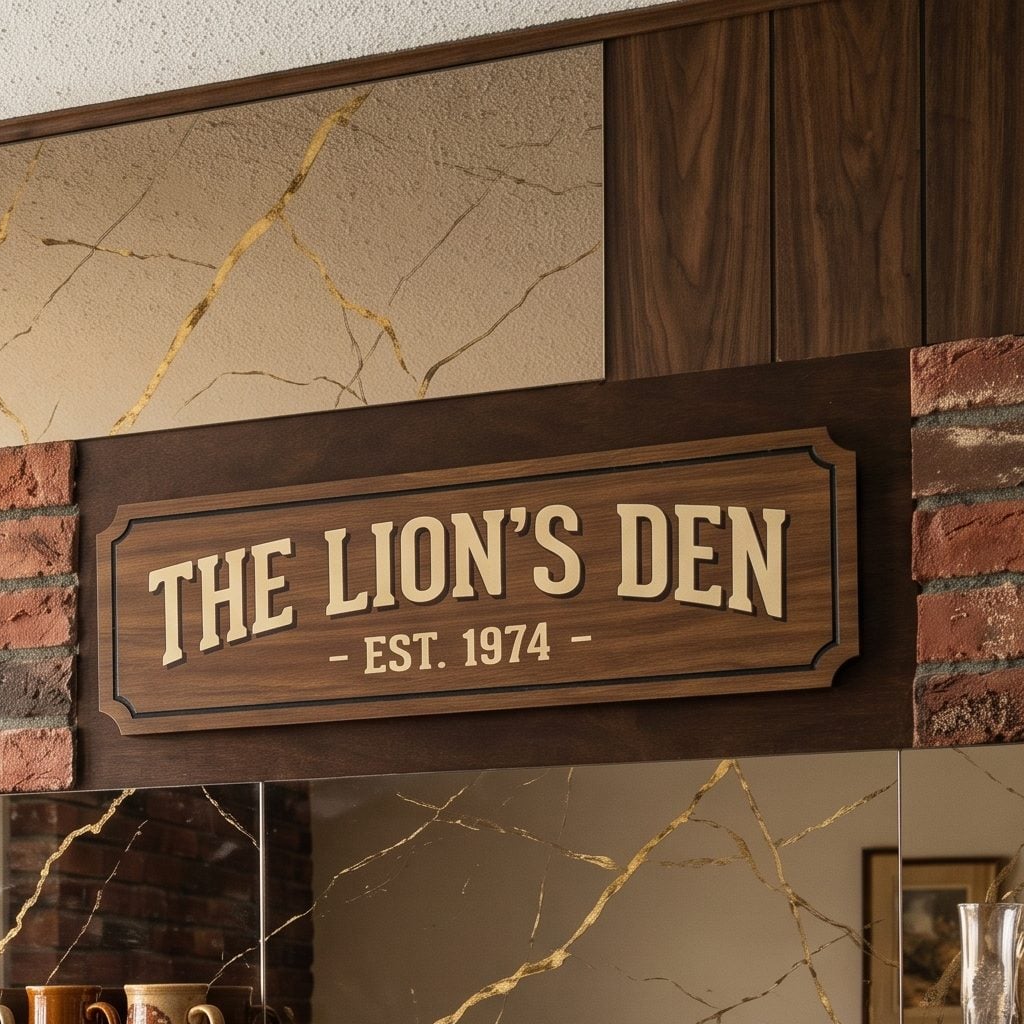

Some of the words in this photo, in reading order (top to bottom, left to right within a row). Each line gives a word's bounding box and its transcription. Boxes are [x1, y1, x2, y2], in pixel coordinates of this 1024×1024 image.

[148, 537, 294, 667] THE
[324, 503, 582, 617] LION'S
[616, 503, 787, 619] DEN
[364, 631, 446, 675] EST.
[462, 621, 551, 667] 1974
